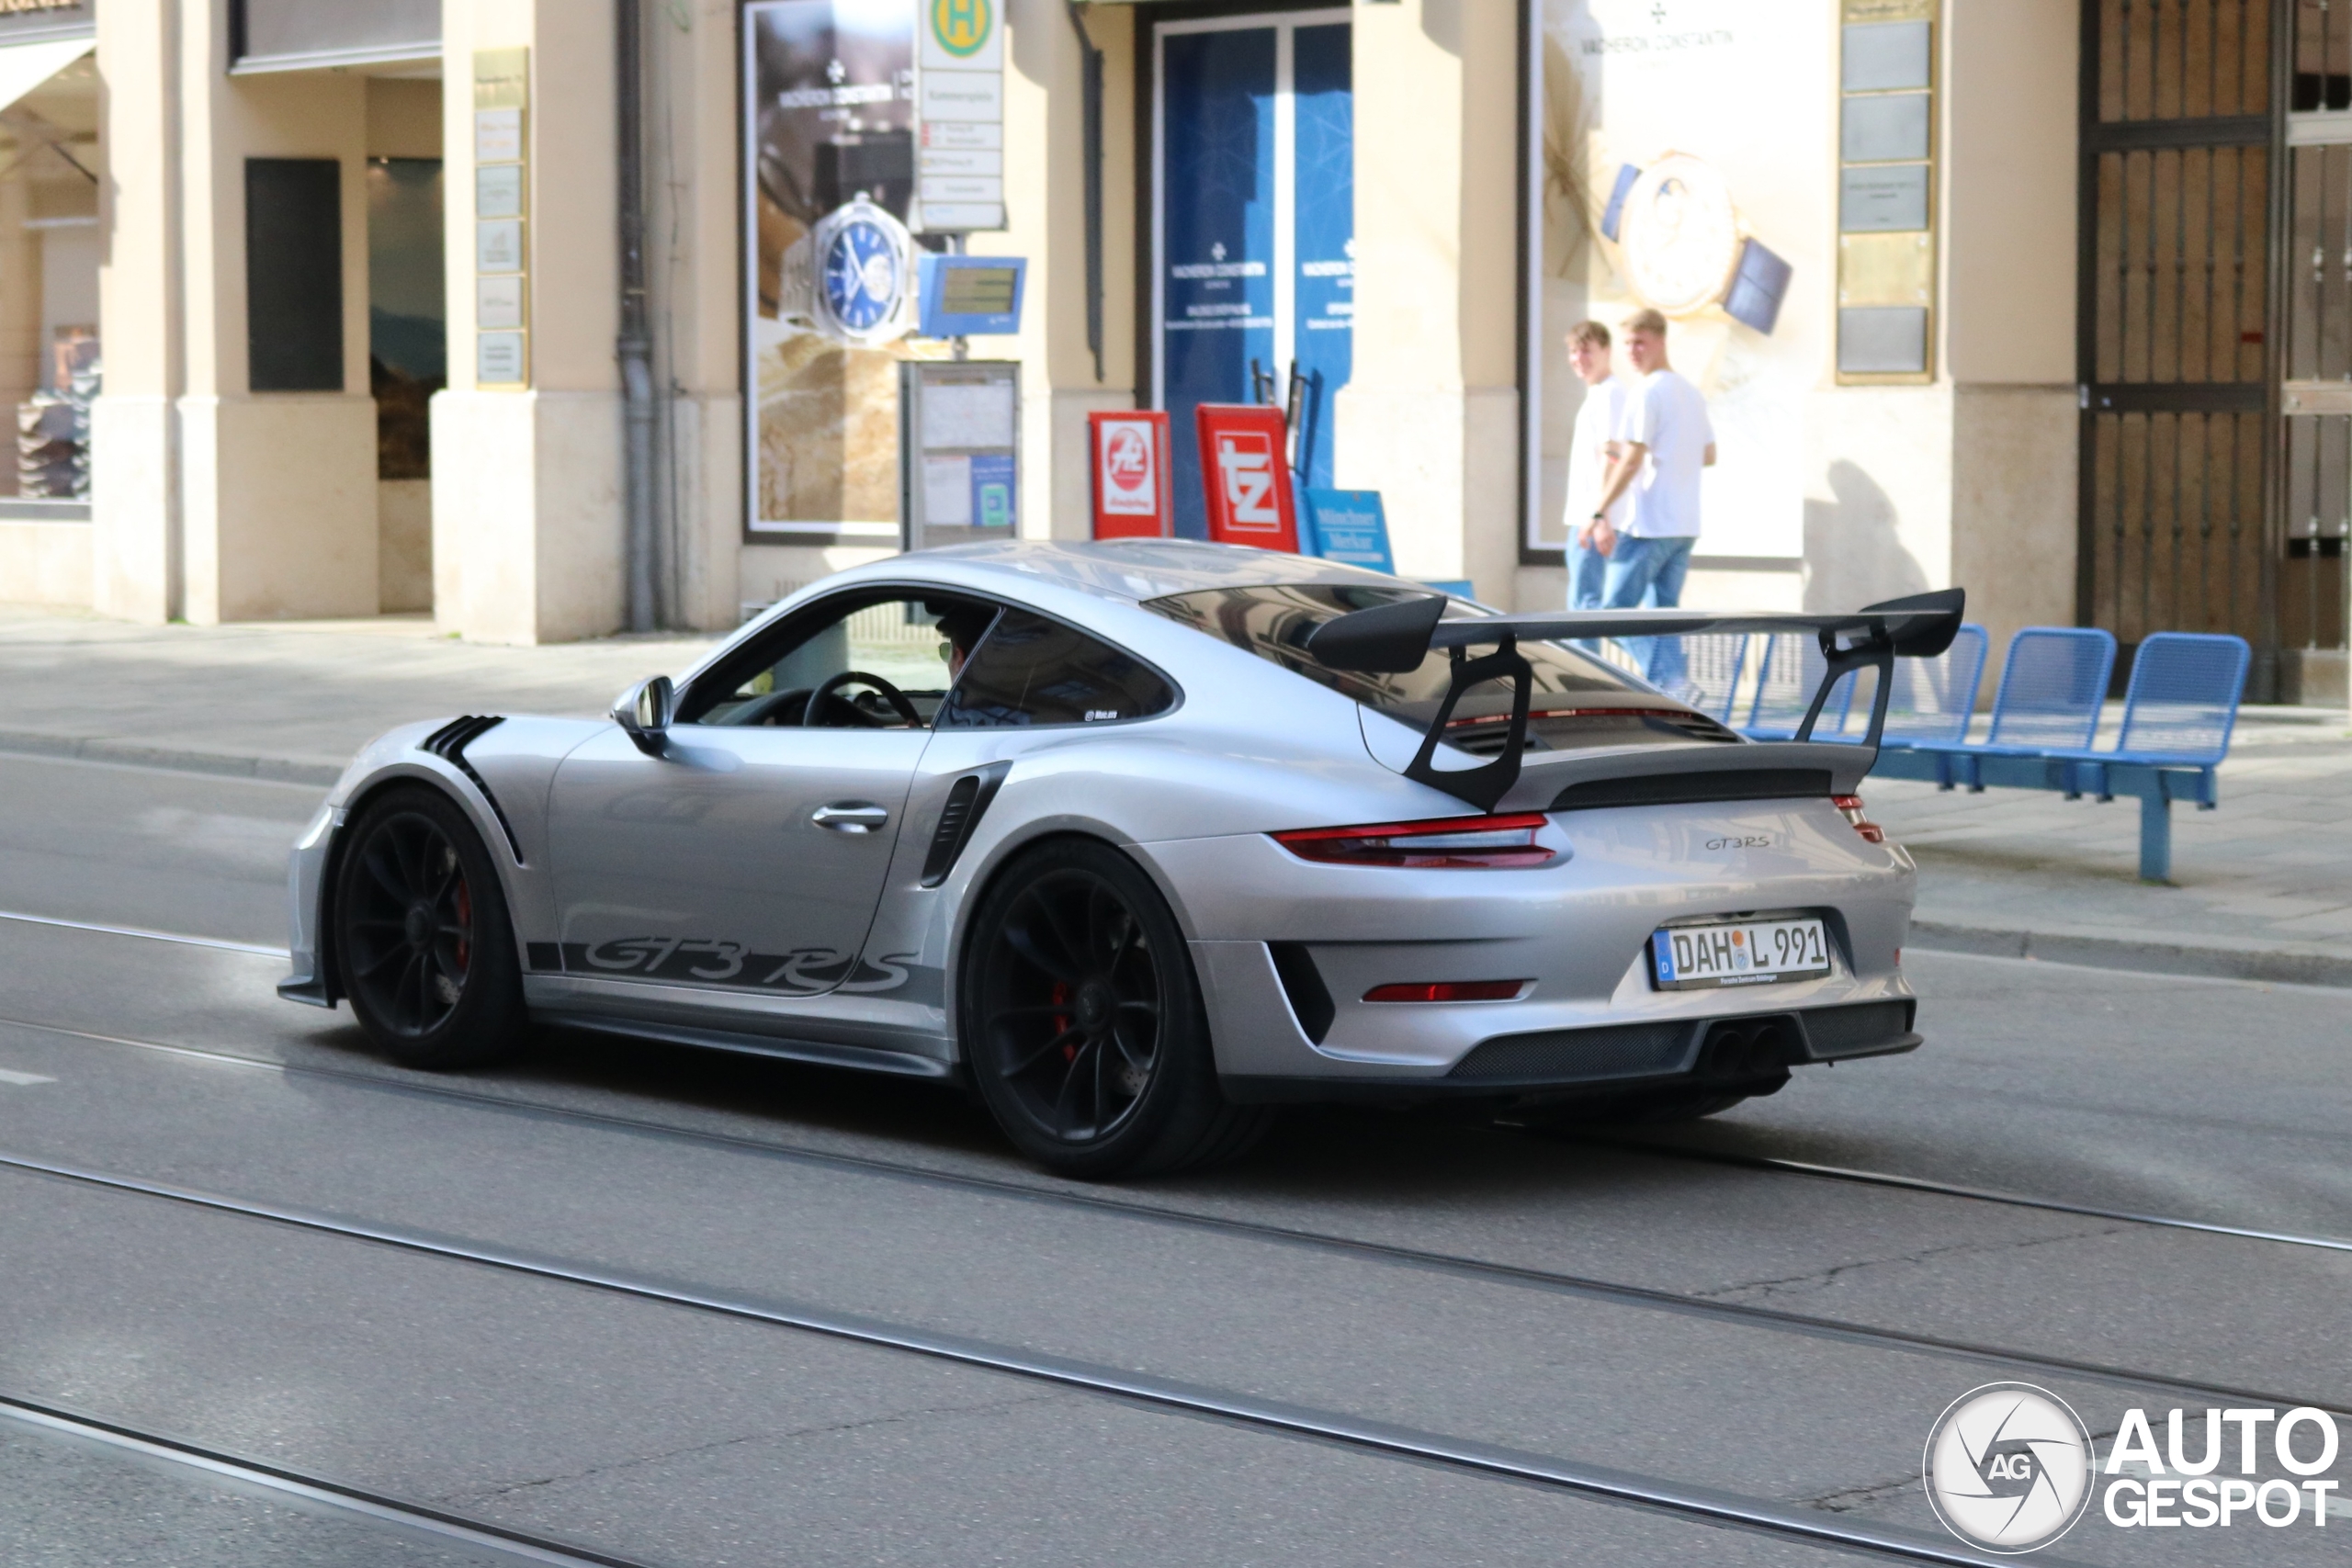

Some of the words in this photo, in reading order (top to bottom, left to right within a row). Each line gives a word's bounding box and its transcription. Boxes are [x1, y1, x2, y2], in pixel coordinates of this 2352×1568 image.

[948, 0, 975, 37] H
[1219, 439, 1279, 524] tz
[1662, 963, 1669, 974] D
[1673, 931, 1734, 974] DAH
[1749, 930, 1770, 968] L
[1774, 926, 1826, 966] 991
